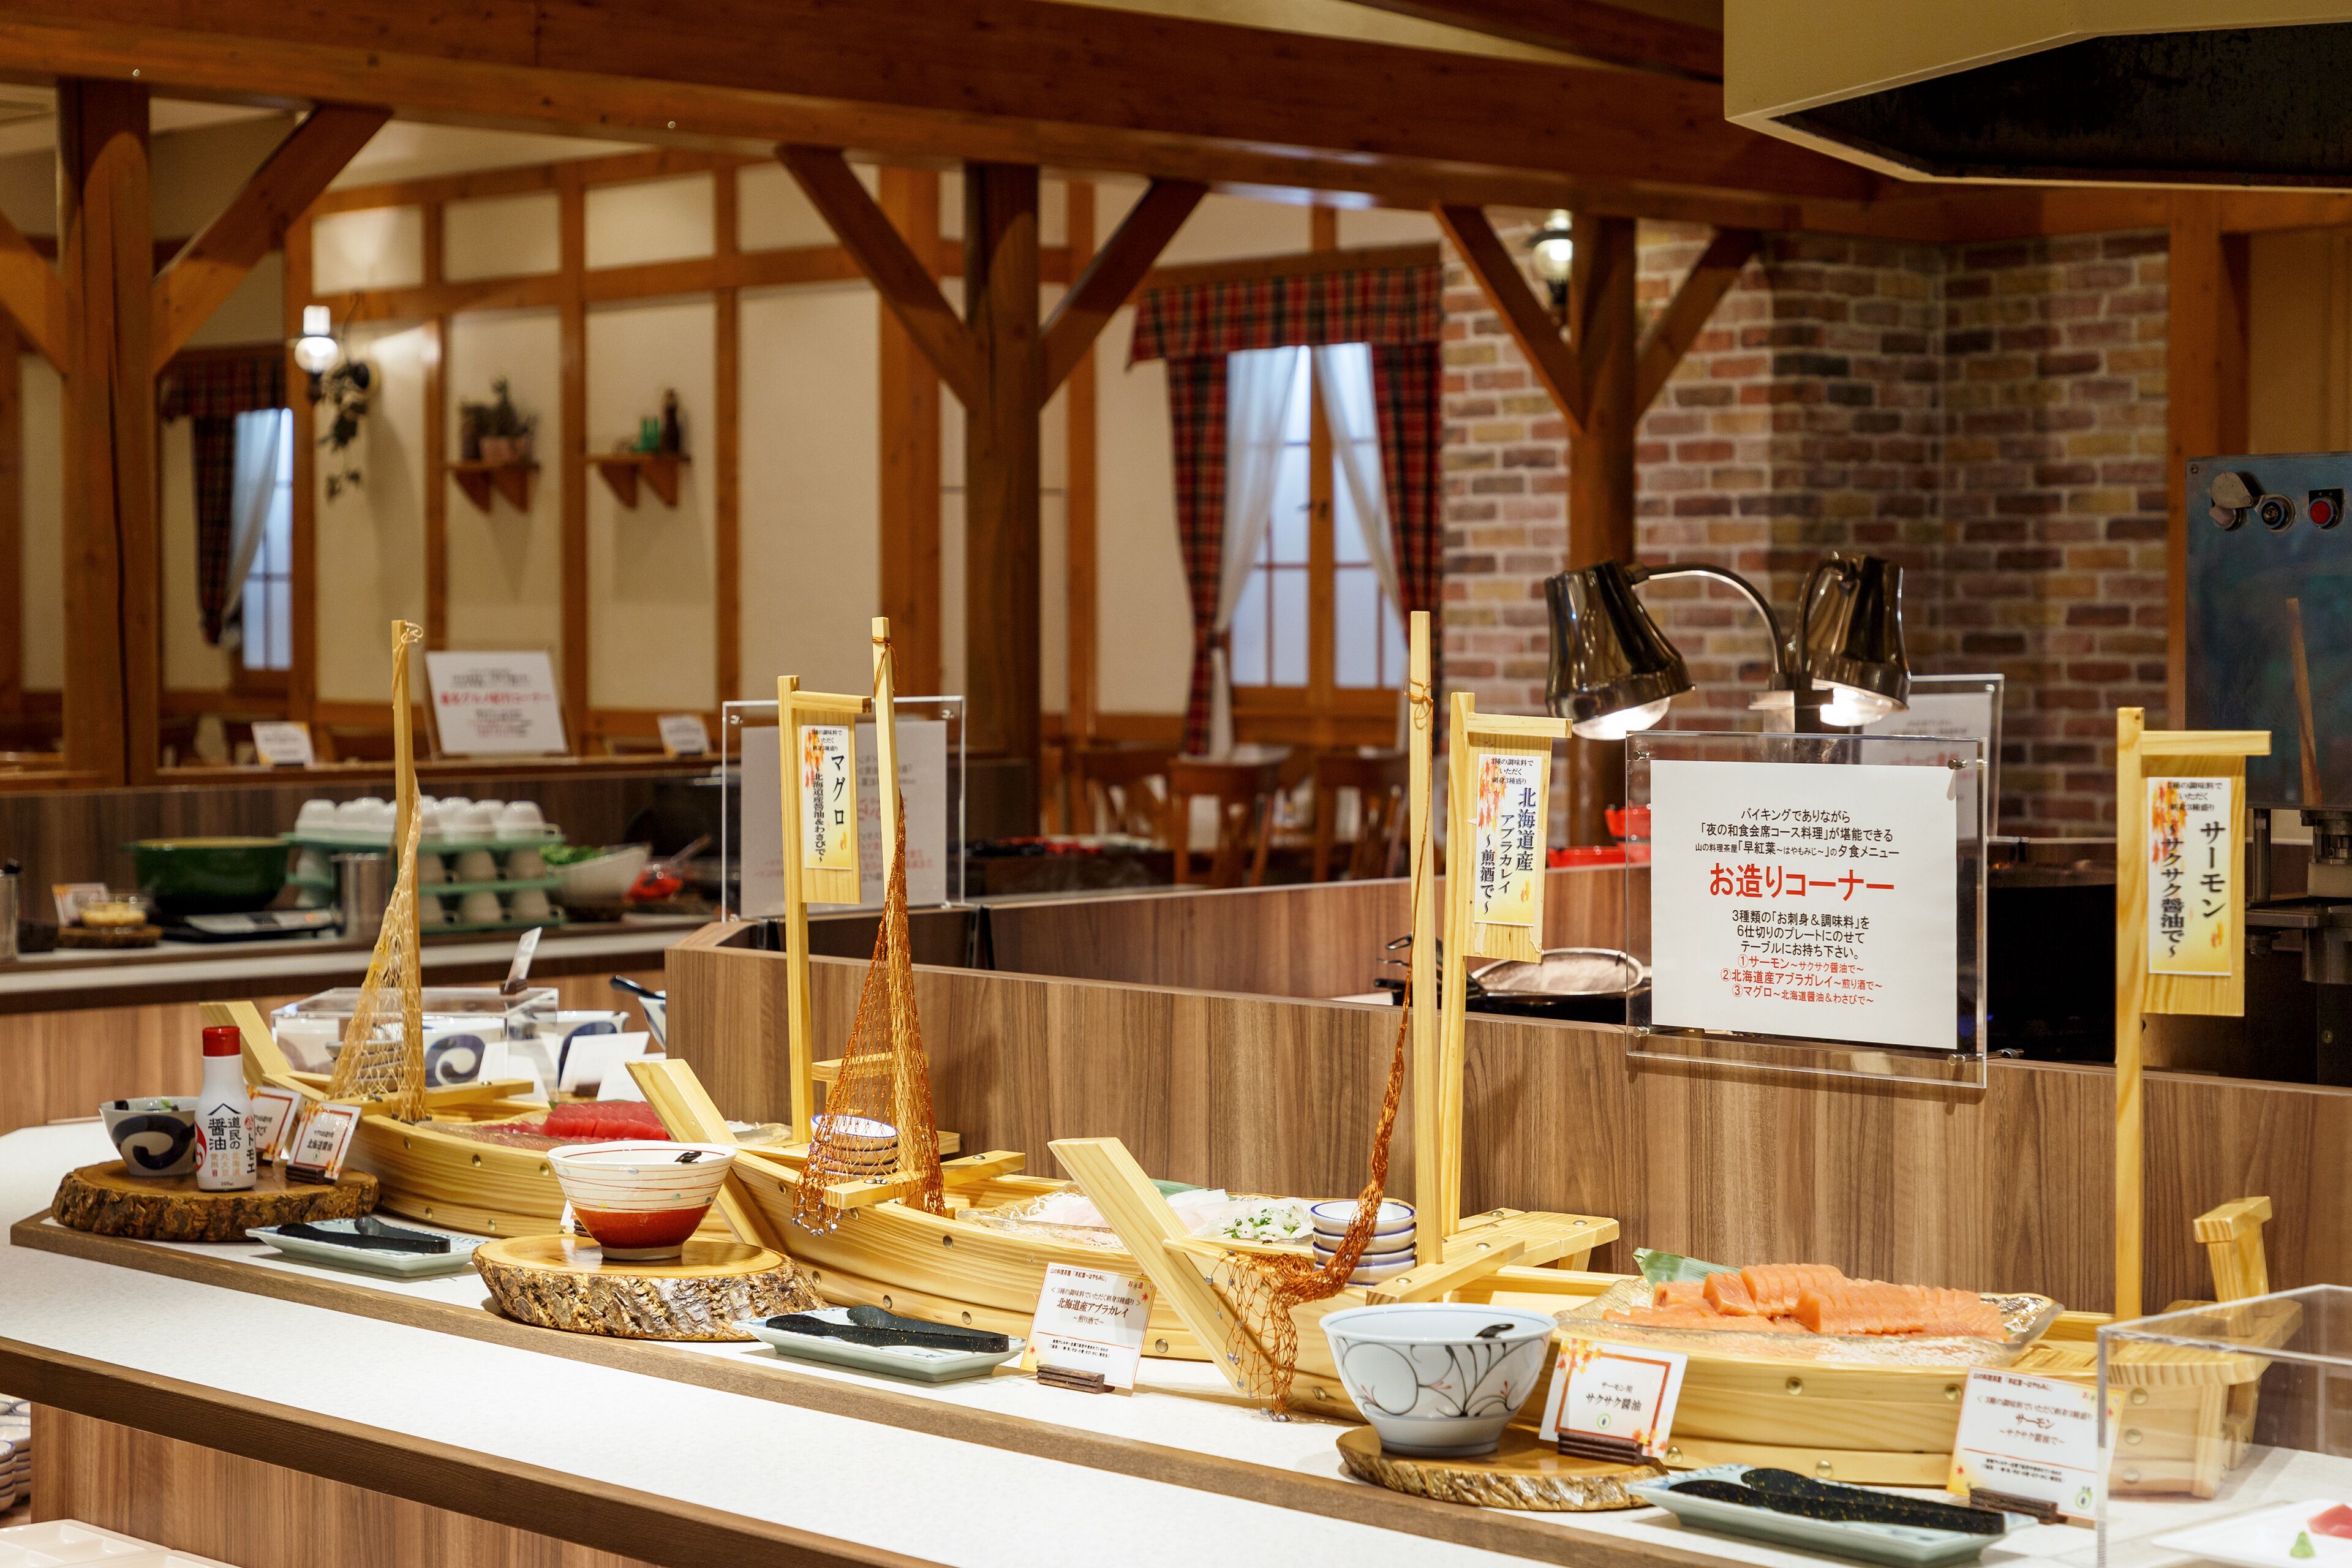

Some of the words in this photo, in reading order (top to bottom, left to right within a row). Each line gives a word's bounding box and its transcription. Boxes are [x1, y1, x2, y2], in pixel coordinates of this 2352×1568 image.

[1491, 758, 1534, 766] 3種の調味料で
[831, 755, 846, 825] マグロ
[1741, 809, 1850, 824] バイキングでありながら
[1515, 787, 1536, 872] 北海道産
[1701, 822, 1893, 842] 「夜の和食会席コース料理」が堪能できる
[1498, 814, 1515, 894] アブラカレイ
[2199, 821, 2226, 918] サーモン
[1709, 862, 1894, 902] お造りコーナー
[1732, 910, 1870, 930] 3種類の「お刺身＆調味料」を
[1737, 925, 1865, 944] 6仕切りのプレートにのせて
[1741, 941, 1858, 960] テーブルにお持ち下さい。
[208, 1117, 227, 1150] 醤油
[228, 1116, 242, 1150] 道民の
[246, 1133, 255, 1174] トモエ
[1128, 1280, 1154, 1291] お造り
[1057, 1297, 1129, 1318] 北海道産アブラカレイ
[1601, 1382, 1633, 1393] サーモン用
[2082, 1390, 2120, 1404] おり
[1586, 1393, 1642, 1412] サクサク醤油
[2016, 1413, 2055, 1430] サーモン
